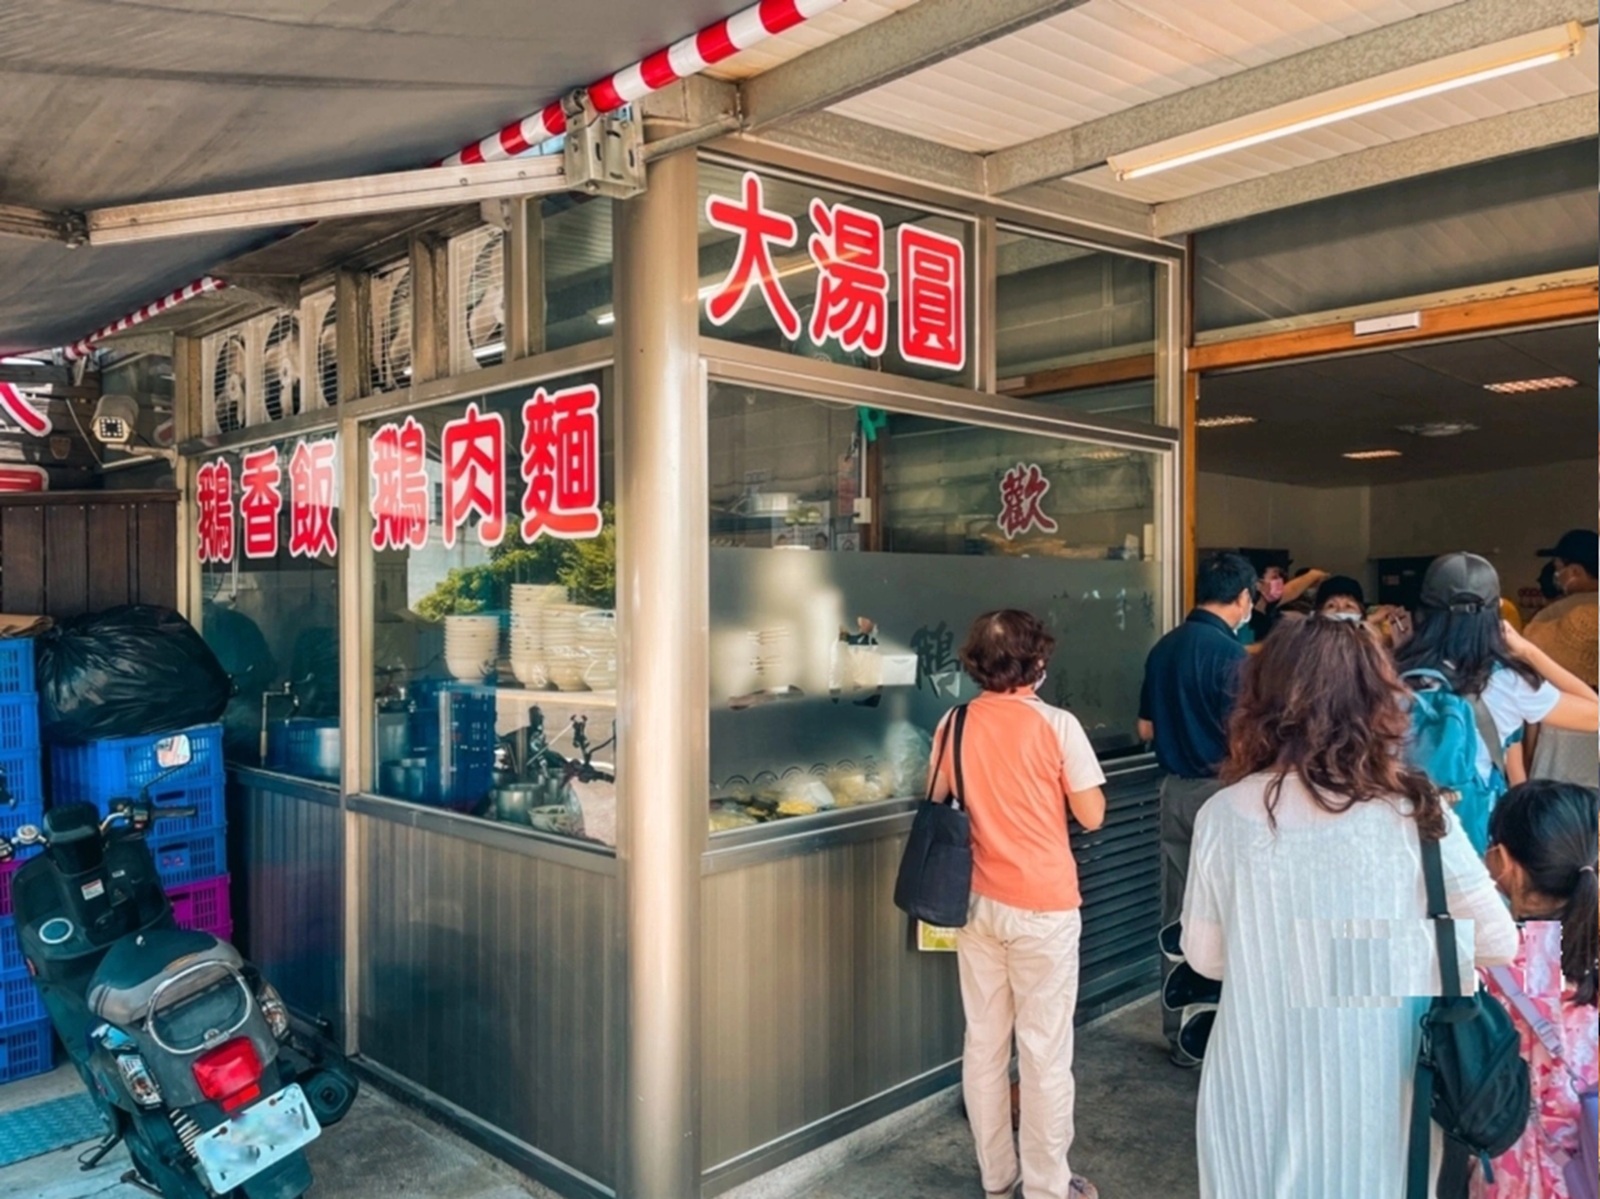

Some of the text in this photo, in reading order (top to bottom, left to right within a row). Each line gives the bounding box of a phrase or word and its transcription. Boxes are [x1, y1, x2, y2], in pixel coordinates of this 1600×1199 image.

[705, 171, 965, 371] 大湯圓
[197, 440, 338, 564] 鵝香飯
[371, 384, 602, 552] 鵝肉麵
[998, 462, 1058, 540] 歡
